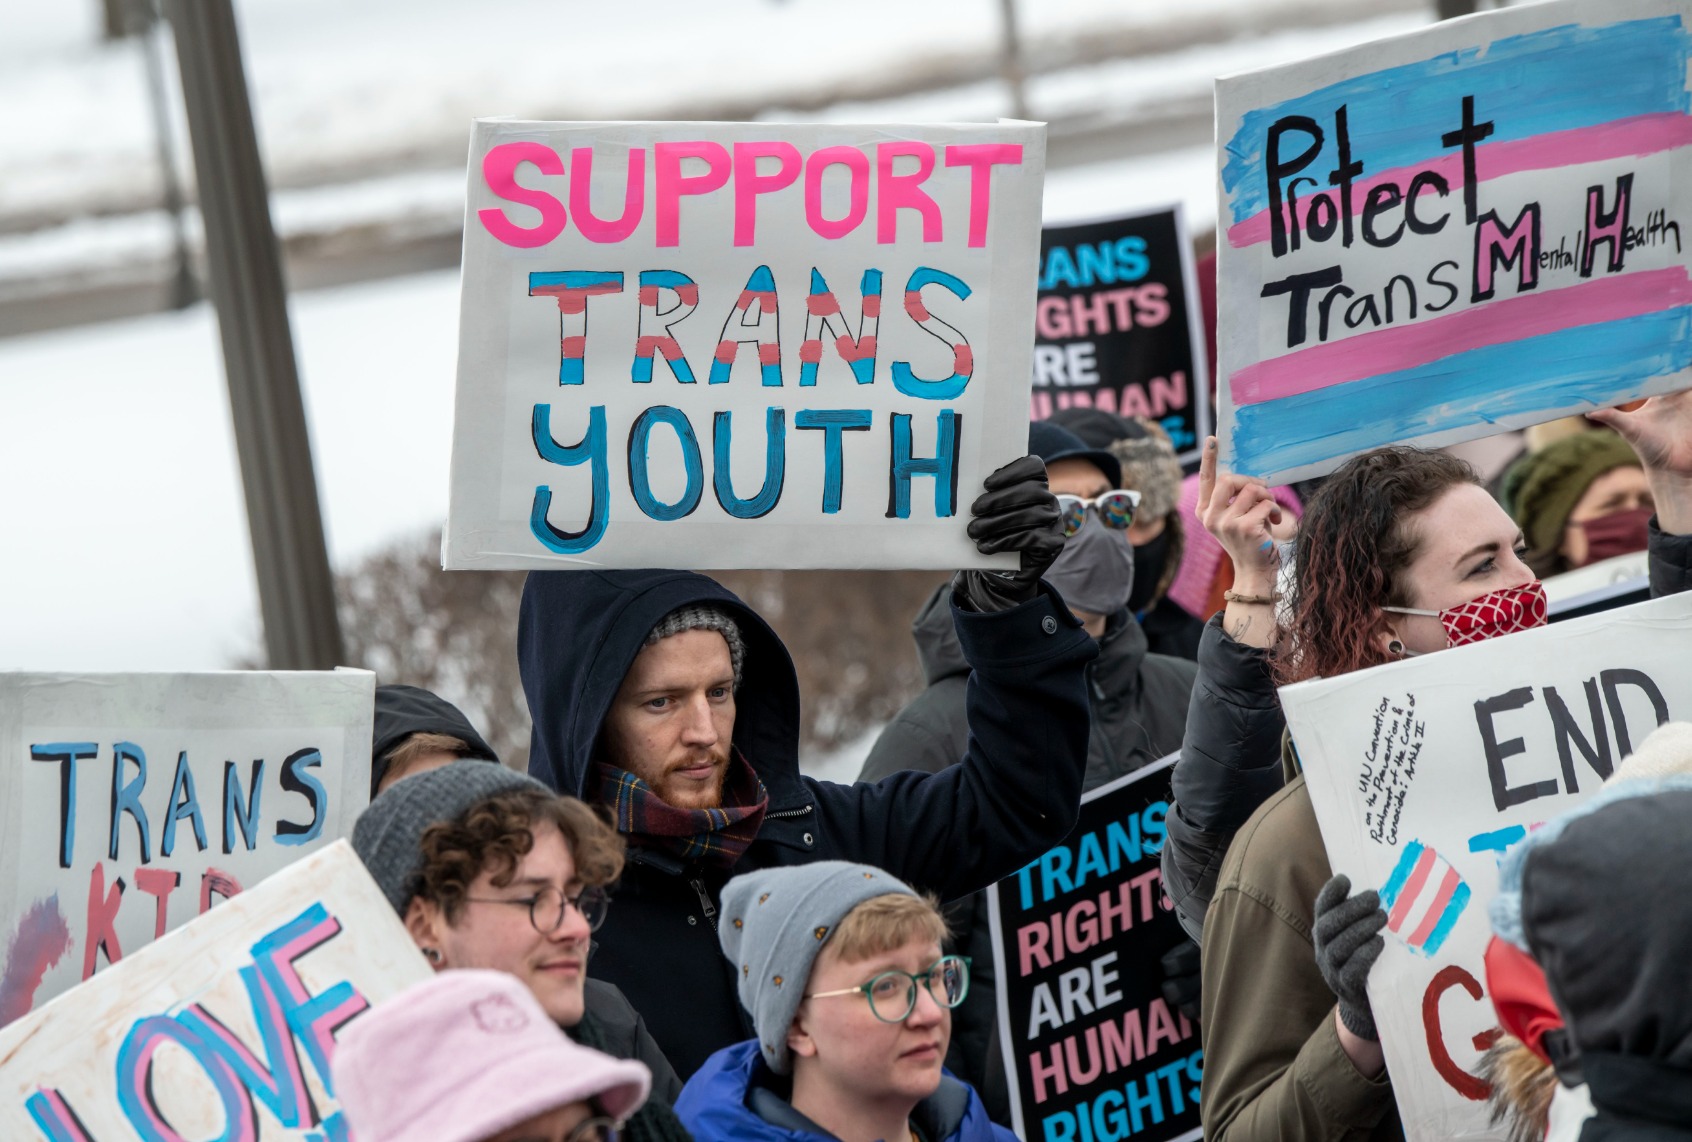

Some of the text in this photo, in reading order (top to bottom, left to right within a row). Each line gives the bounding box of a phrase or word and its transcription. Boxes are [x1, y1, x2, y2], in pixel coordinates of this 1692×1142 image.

[478, 141, 1023, 249] SUPPORT
[1265, 95, 1494, 258] Protect
[1035, 282, 1170, 340] GHTS
[1037, 236, 1150, 290] ANS
[1260, 172, 1681, 348] Trans Mental Health
[528, 265, 974, 400] TRANS
[1032, 342, 1101, 387] RE
[529, 403, 963, 554] YOUTH
[1359, 763, 1373, 793] UN
[1393, 750, 1406, 767] the
[1400, 710, 1414, 746] Crime
[1473, 668, 1670, 812] END
[30, 741, 328, 868] TRANS
[1366, 793, 1378, 808] the
[1008, 801, 1169, 911] TRANS
[1028, 951, 1123, 1040] ARE
